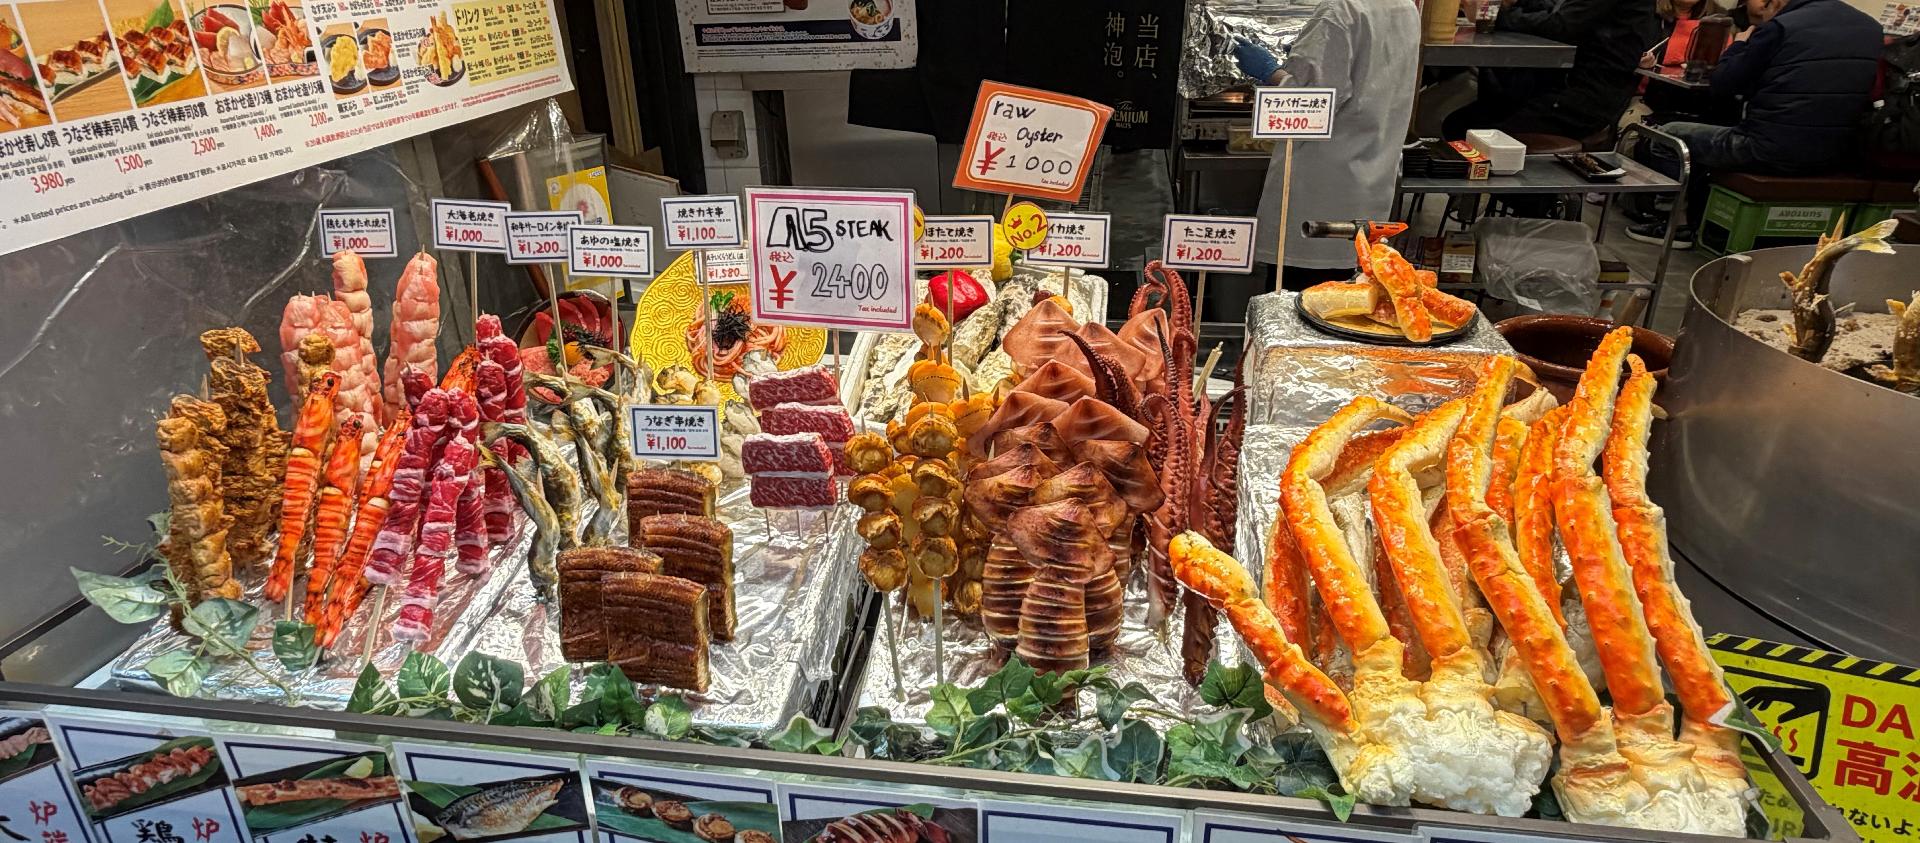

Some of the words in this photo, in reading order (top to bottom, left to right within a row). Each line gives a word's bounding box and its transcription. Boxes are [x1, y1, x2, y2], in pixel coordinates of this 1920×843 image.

[455, 8, 480, 25] ドリンク
[1104, 11, 1126, 78] 神泡。
[1134, 13, 1160, 79] 当店、
[274, 79, 326, 102] おまかせ造り5種
[214, 90, 274, 114] おまかせ造り3種
[1264, 97, 1328, 109] タラバガニ焼き
[142, 101, 209, 128] うなぎ棒寿司8貫
[993, 101, 1036, 119] raw
[1112, 110, 1149, 124] EMIUM
[62, 114, 140, 145] うなぎ棒寿司4貫
[1268, 117, 1309, 131] ¥5,400
[254, 123, 276, 141] 1,400
[1017, 127, 1063, 148] Oyster
[191, 136, 217, 156] 2,500
[115, 153, 144, 175] 1,500
[144, 158, 153, 168] yen
[976, 141, 1006, 175] ¥
[30, 171, 65, 194] 3,980
[65, 176, 76, 187] yen
[31, 207, 54, 220] listed
[55, 203, 78, 216] prices
[79, 200, 91, 209] are
[92, 192, 125, 205] including
[677, 206, 724, 218] 焼きカキ串
[447, 209, 494, 222] 大海老焼き
[326, 217, 387, 229] 鶏もも串たれ焼き
[511, 220, 576, 233] 和牛サーロイン串
[766, 206, 835, 253] A5
[835, 219, 894, 241] STEAK
[1047, 223, 1086, 235] イカ焼き
[446, 228, 483, 242] ¥1,000
[678, 227, 715, 241] ¥1,100
[925, 226, 975, 237] ほたて焼き
[1184, 226, 1236, 239] たこ足焼き
[333, 237, 369, 250] ¥1,000
[518, 241, 560, 254] ¥1,200
[580, 235, 641, 247] あゆの塩焼き
[920, 246, 964, 260] ¥1,200
[1039, 243, 1082, 257] ¥1,200
[1177, 247, 1222, 261] ¥1,200
[583, 255, 623, 268] ¥1,000
[709, 267, 740, 279] ¥1,580
[768, 264, 798, 309] ¥
[811, 262, 889, 300] 2400
[858, 304, 870, 312] Tax
[870, 305, 897, 314] included
[644, 415, 705, 427] うなぎ串焼き
[647, 436, 687, 450] ¥1,100
[1841, 694, 1915, 740] DA
[1834, 804, 1920, 836] ないよ
